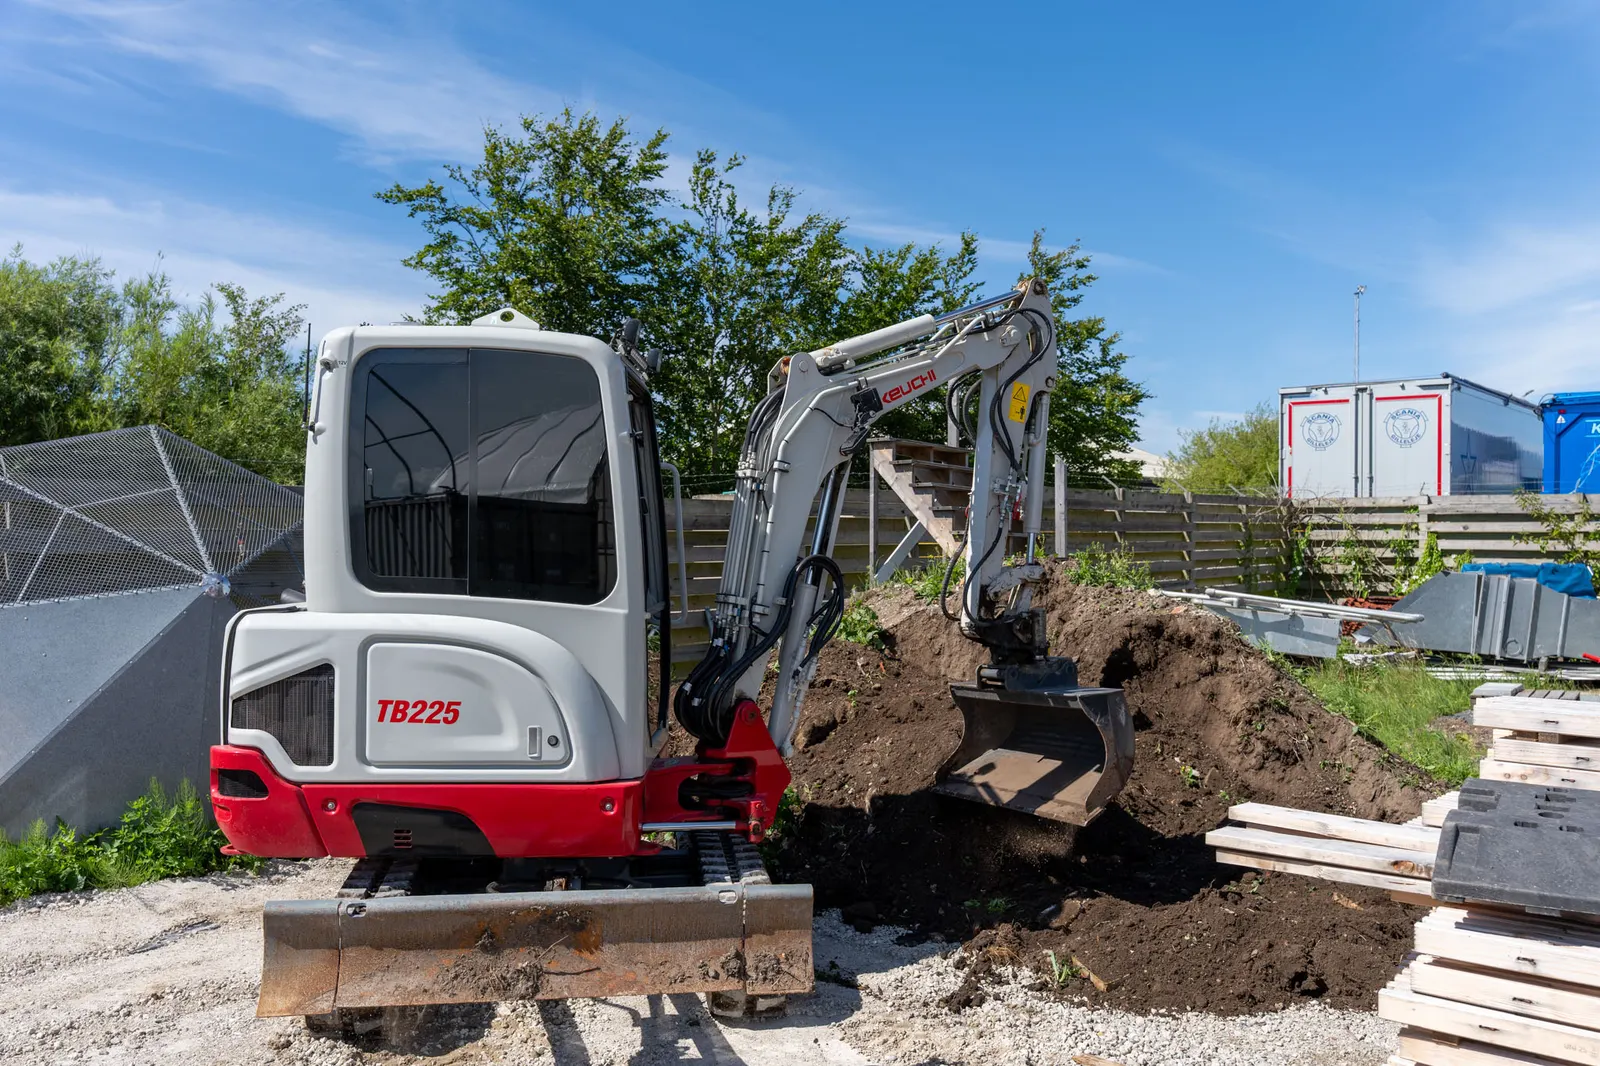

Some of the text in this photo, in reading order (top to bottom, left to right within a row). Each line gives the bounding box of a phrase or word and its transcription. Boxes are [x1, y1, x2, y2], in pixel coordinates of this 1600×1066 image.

[1307, 414, 1335, 424] SCANIA
[1391, 409, 1420, 420] SCANIA
[1307, 437, 1334, 447] GILLELEJE
[1391, 434, 1420, 444] GILLELEJE
[377, 699, 462, 724] TB225
